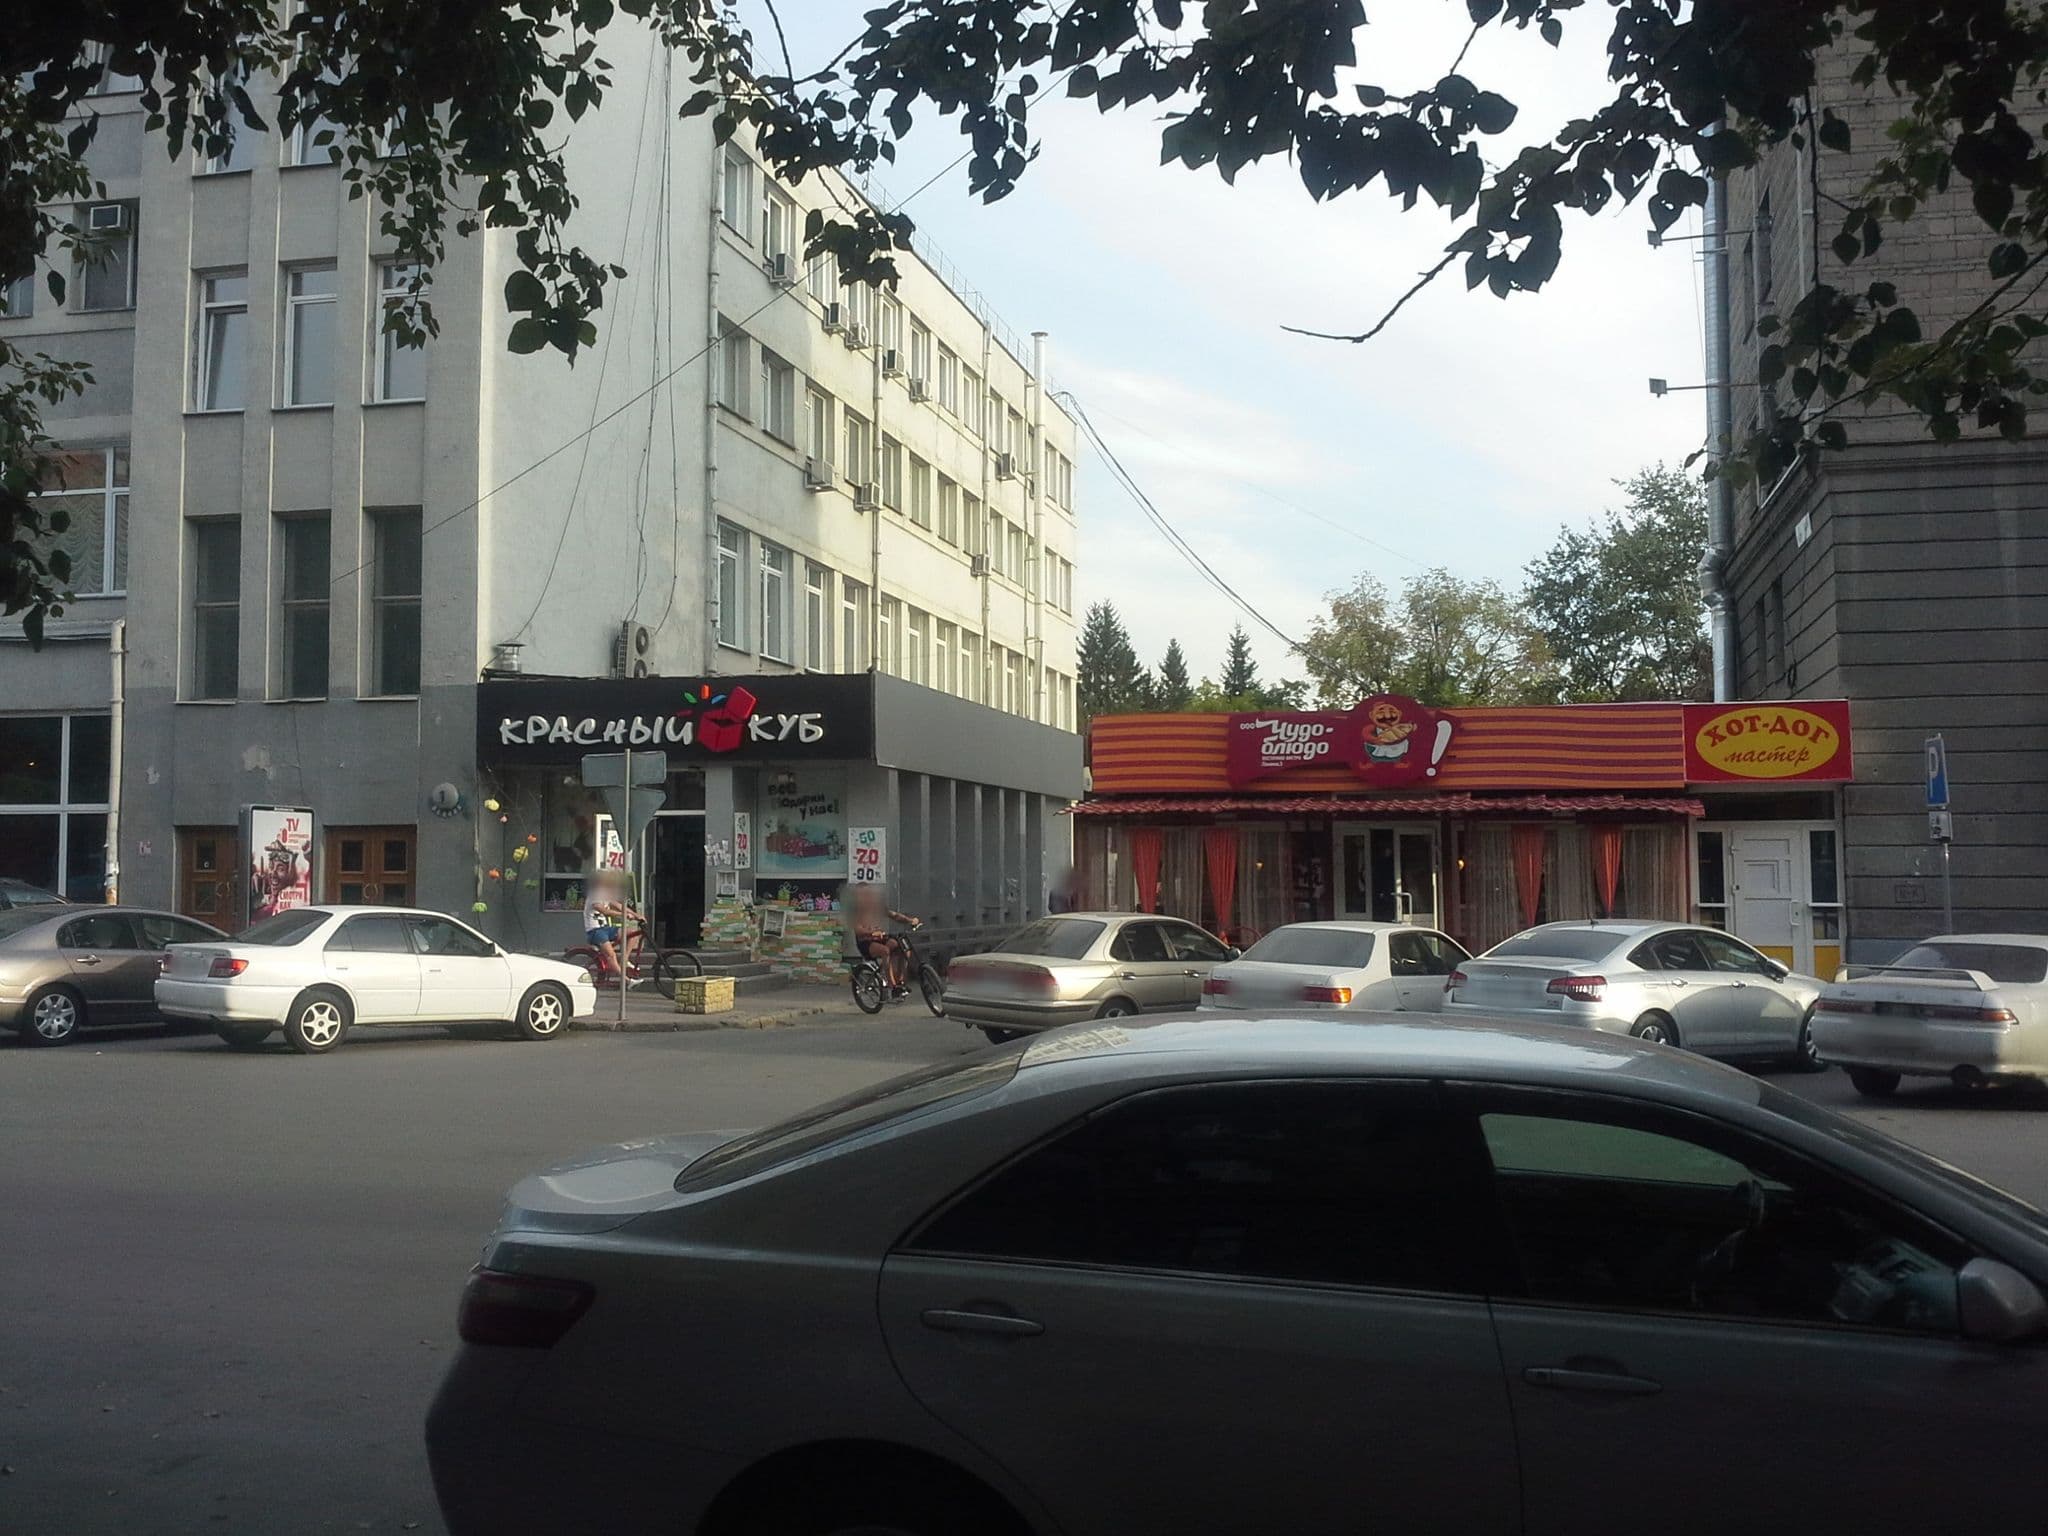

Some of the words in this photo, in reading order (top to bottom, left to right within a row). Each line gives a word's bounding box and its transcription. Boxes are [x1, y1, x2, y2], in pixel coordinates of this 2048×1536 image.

[498, 714, 693, 745] КРАСНЫЙ
[748, 713, 824, 743] КУБ
[1704, 715, 1830, 747] ХОТ-ДОГ
[1261, 735, 1329, 760] блюдо
[1723, 745, 1812, 767] мастер
[286, 818, 300, 831] TV
